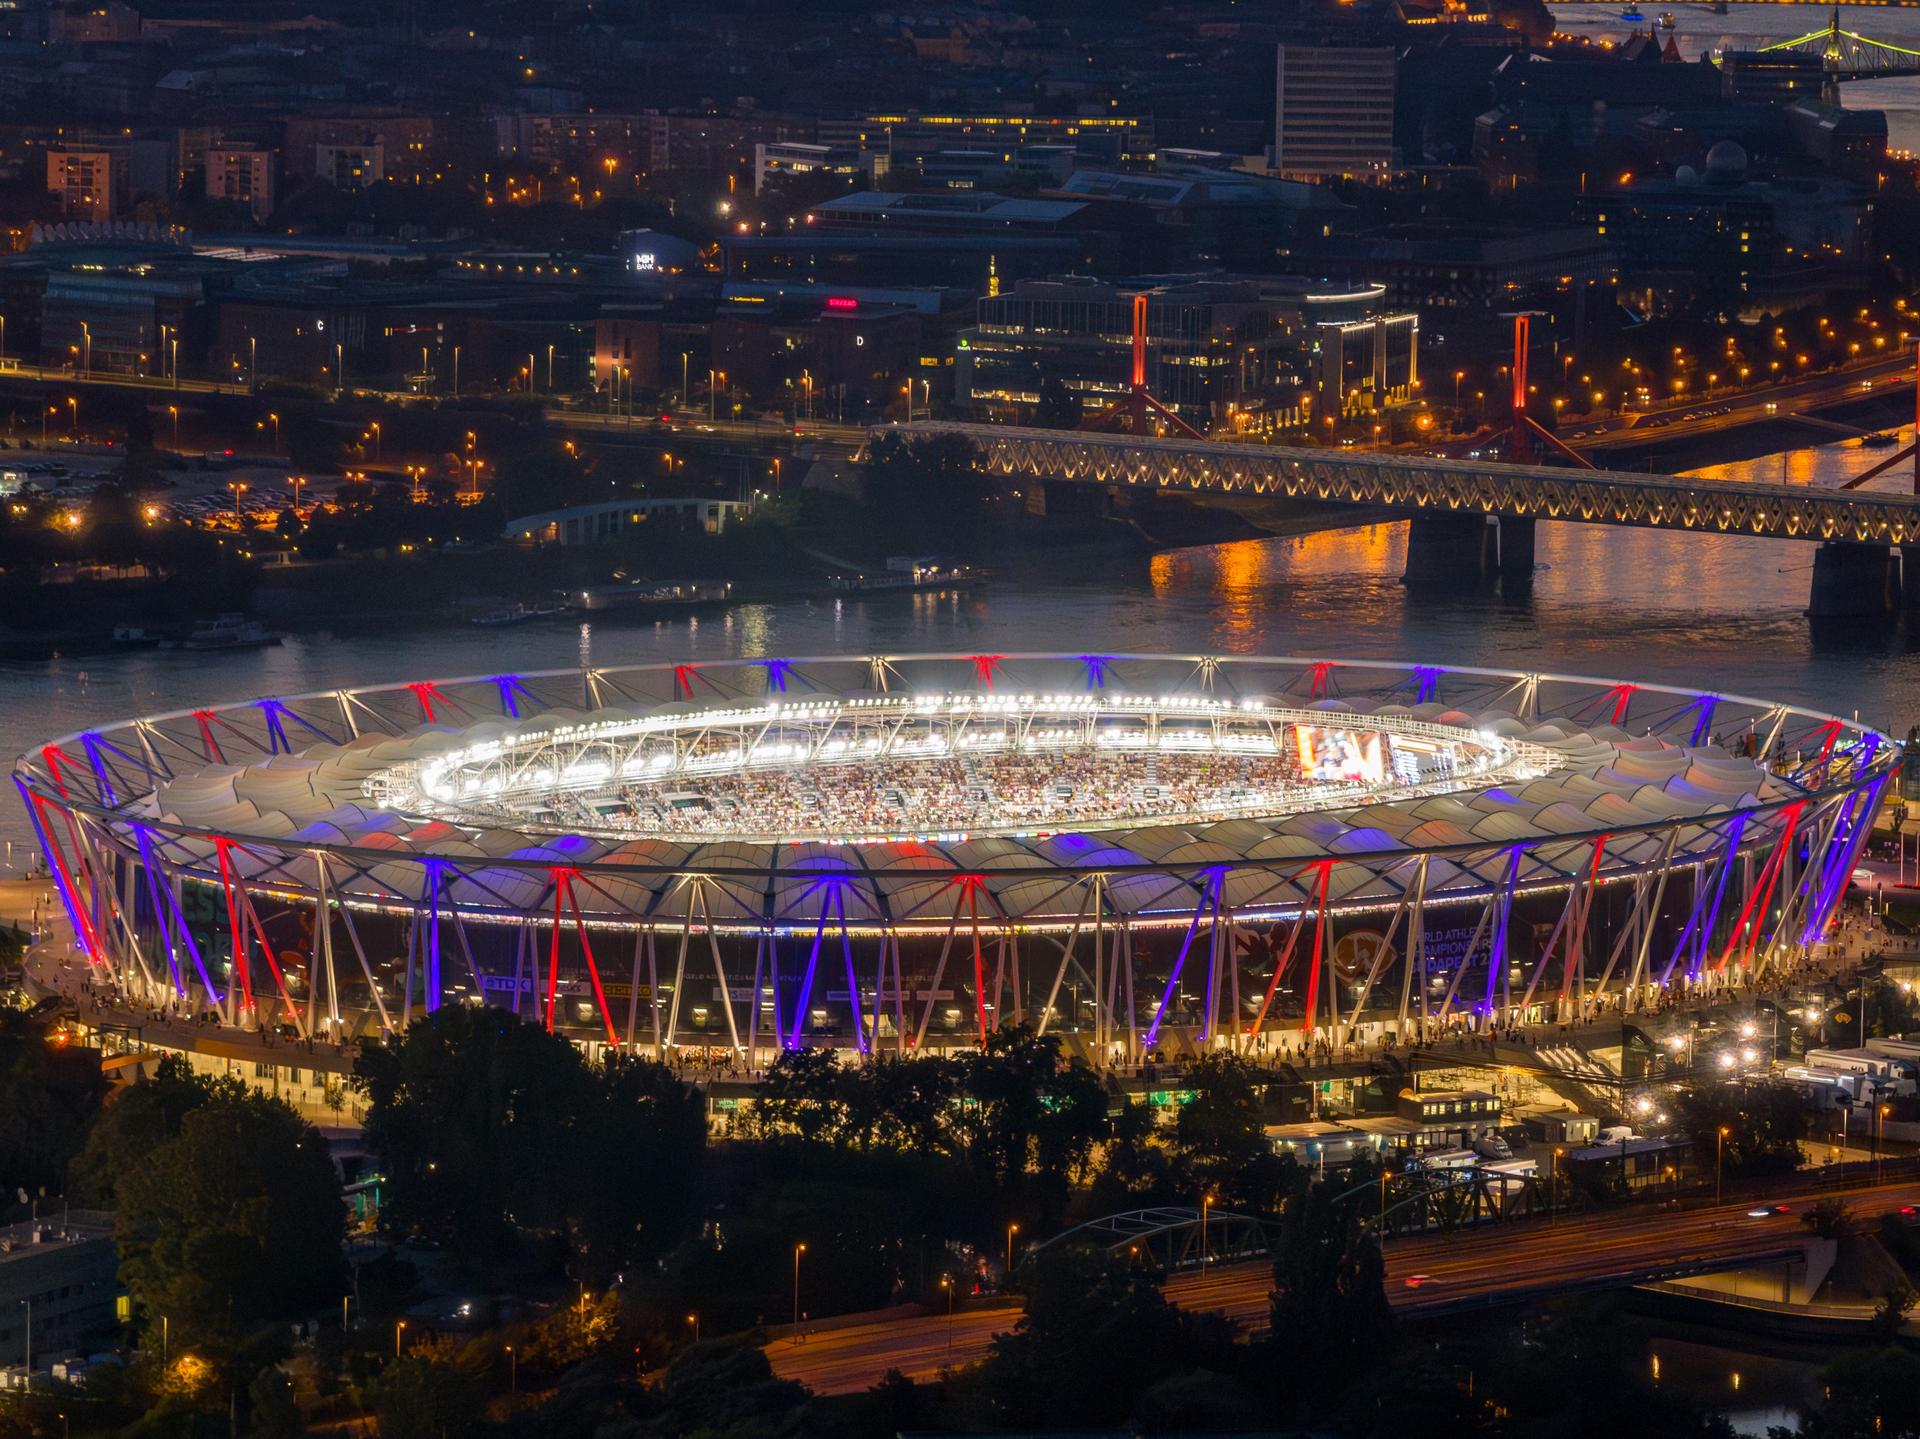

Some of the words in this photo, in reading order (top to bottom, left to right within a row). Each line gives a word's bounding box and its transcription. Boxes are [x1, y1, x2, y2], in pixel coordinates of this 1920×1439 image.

[856, 335, 864, 346] D
[1445, 925, 1492, 941] ATHLEC
[1414, 954, 1479, 973] DAPET
[497, 977, 530, 990] TDK
